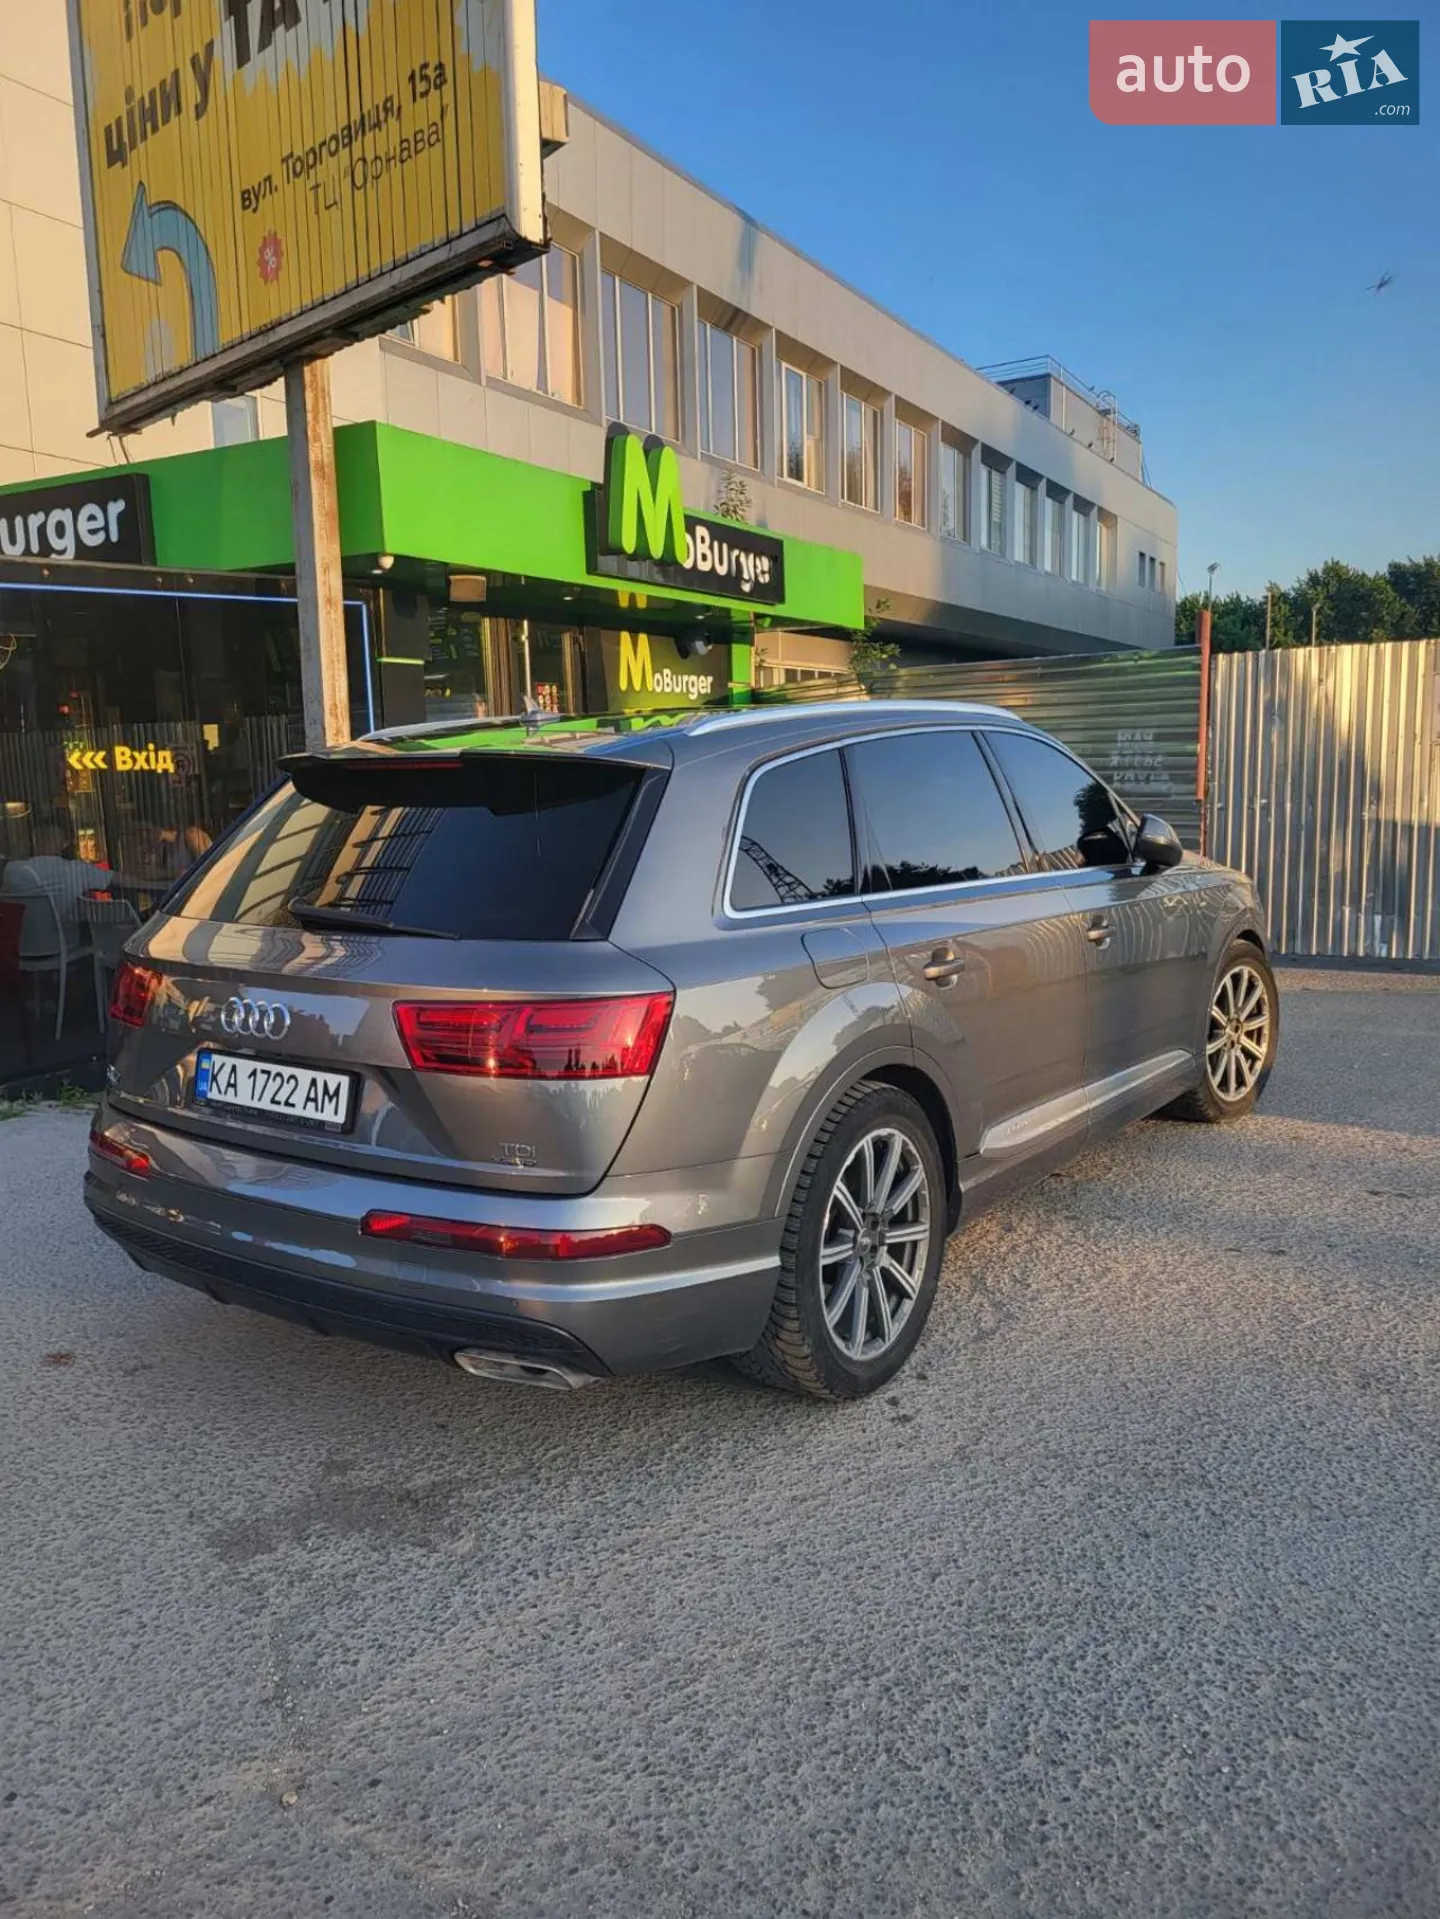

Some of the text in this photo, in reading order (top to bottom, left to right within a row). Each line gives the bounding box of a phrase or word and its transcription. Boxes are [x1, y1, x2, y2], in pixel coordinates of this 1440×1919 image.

[104, 67, 182, 169] ціни
[240, 60, 448, 213] вул. Торговиця, 15а
[309, 174, 340, 215] ТЦ
[0, 498, 126, 560] urger
[619, 630, 714, 700] MoBurger
[114, 742, 176, 774] Вхід
[209, 1060, 238, 1098] KA
[247, 1067, 299, 1108] 1722
[303, 1076, 342, 1117] AM
